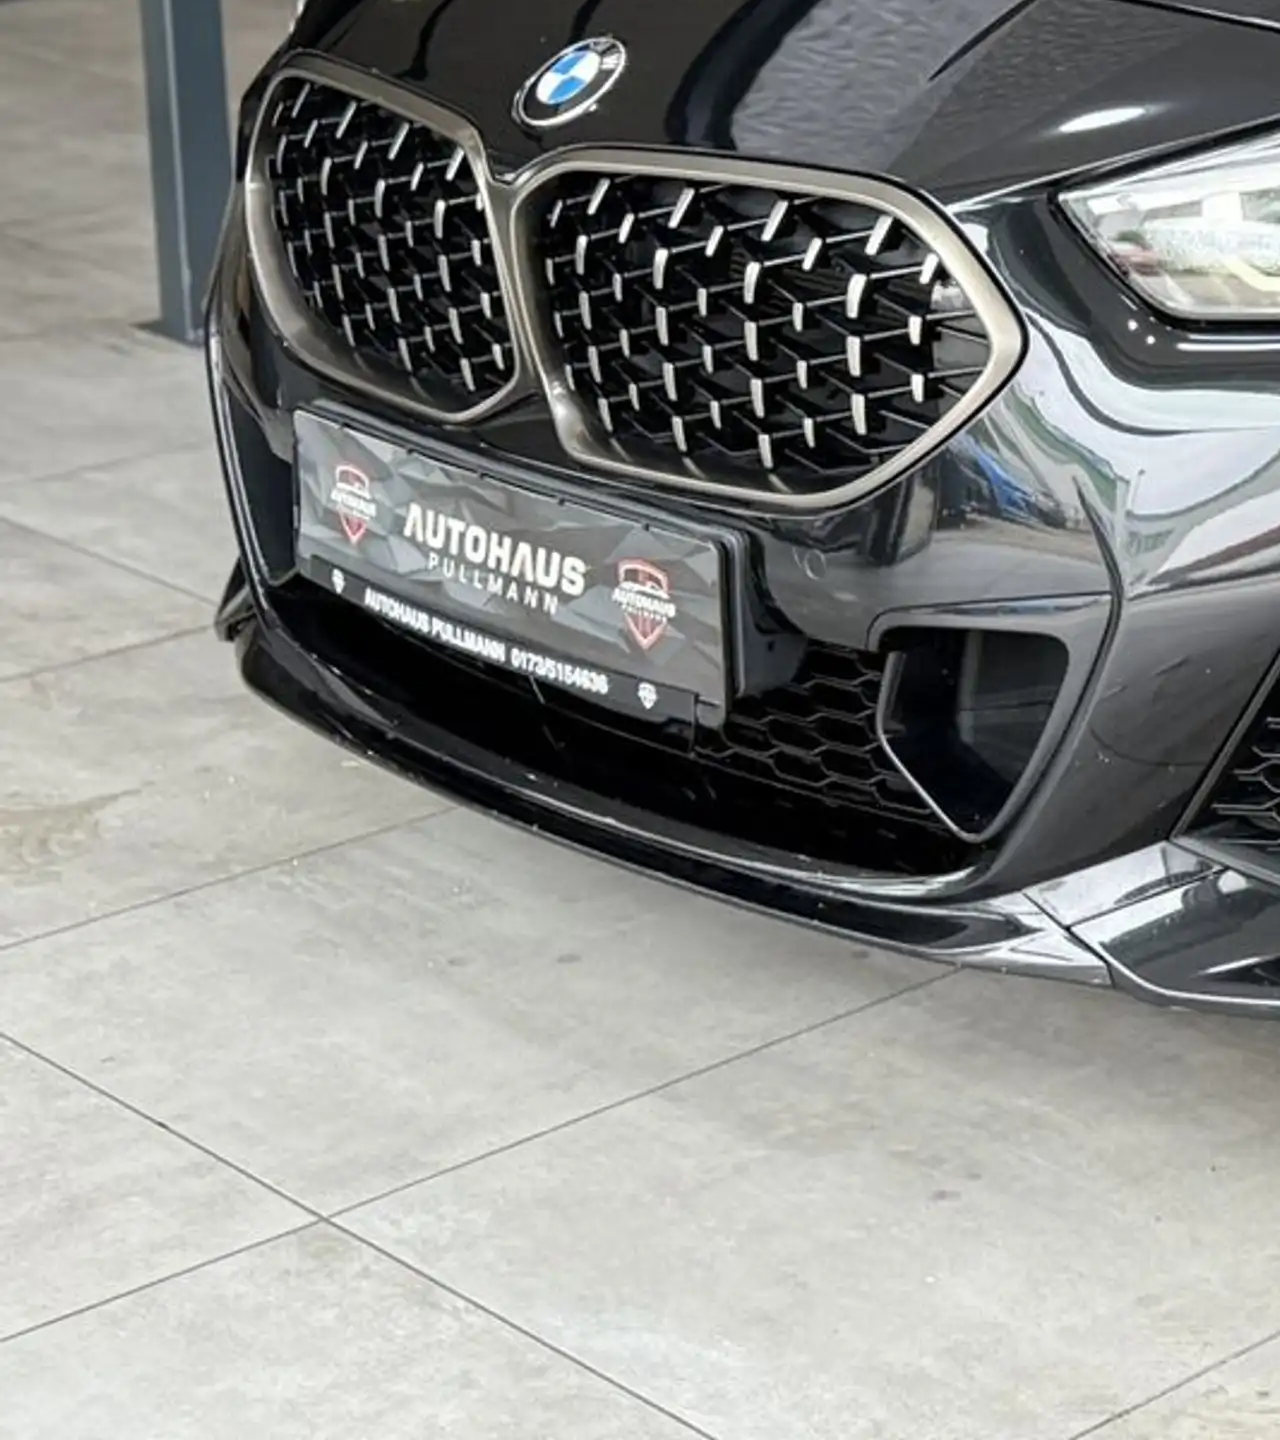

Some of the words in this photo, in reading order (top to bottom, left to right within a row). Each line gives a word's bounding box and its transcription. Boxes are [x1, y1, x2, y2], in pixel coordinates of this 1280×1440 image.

[403, 501, 587, 597] AUTOHAUS
[427, 551, 558, 615] PULLMANN
[364, 587, 431, 637] AUTOHAUS
[431, 616, 506, 665] PULLMANN
